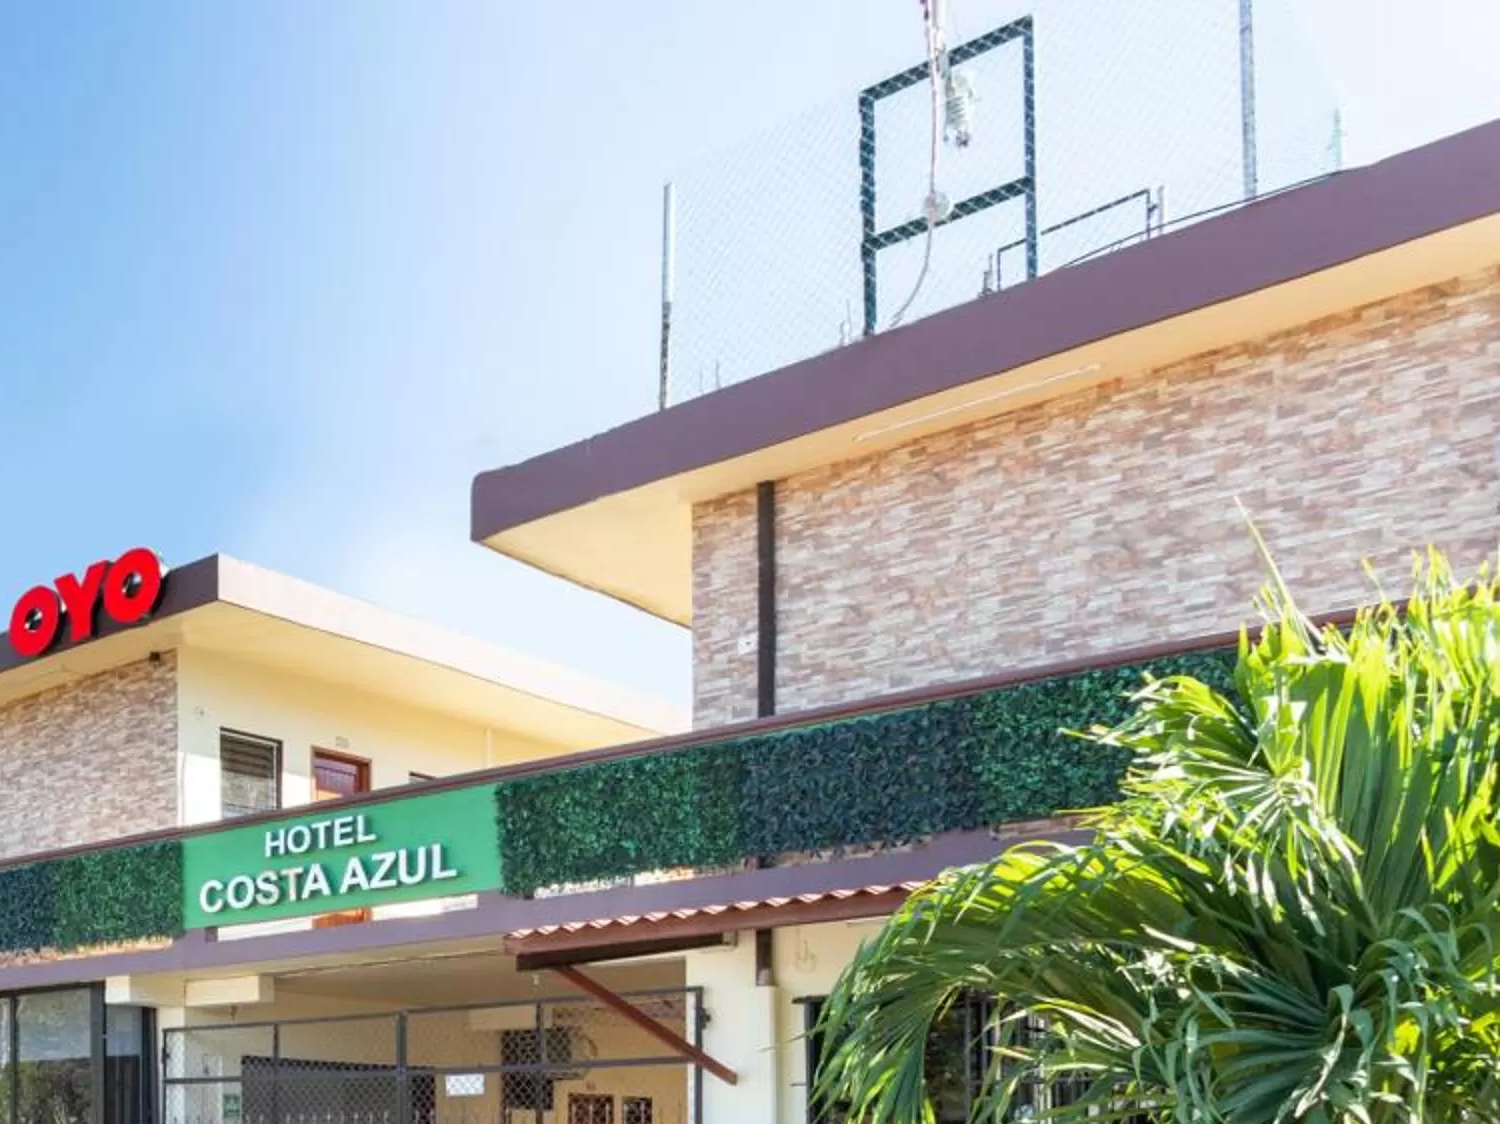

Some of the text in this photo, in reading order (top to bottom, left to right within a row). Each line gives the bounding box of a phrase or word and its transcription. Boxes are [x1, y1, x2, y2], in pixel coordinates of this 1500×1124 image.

[8, 547, 162, 657] OYO
[264, 813, 377, 858] HOTEL
[199, 843, 458, 913] COSTA AZUL
